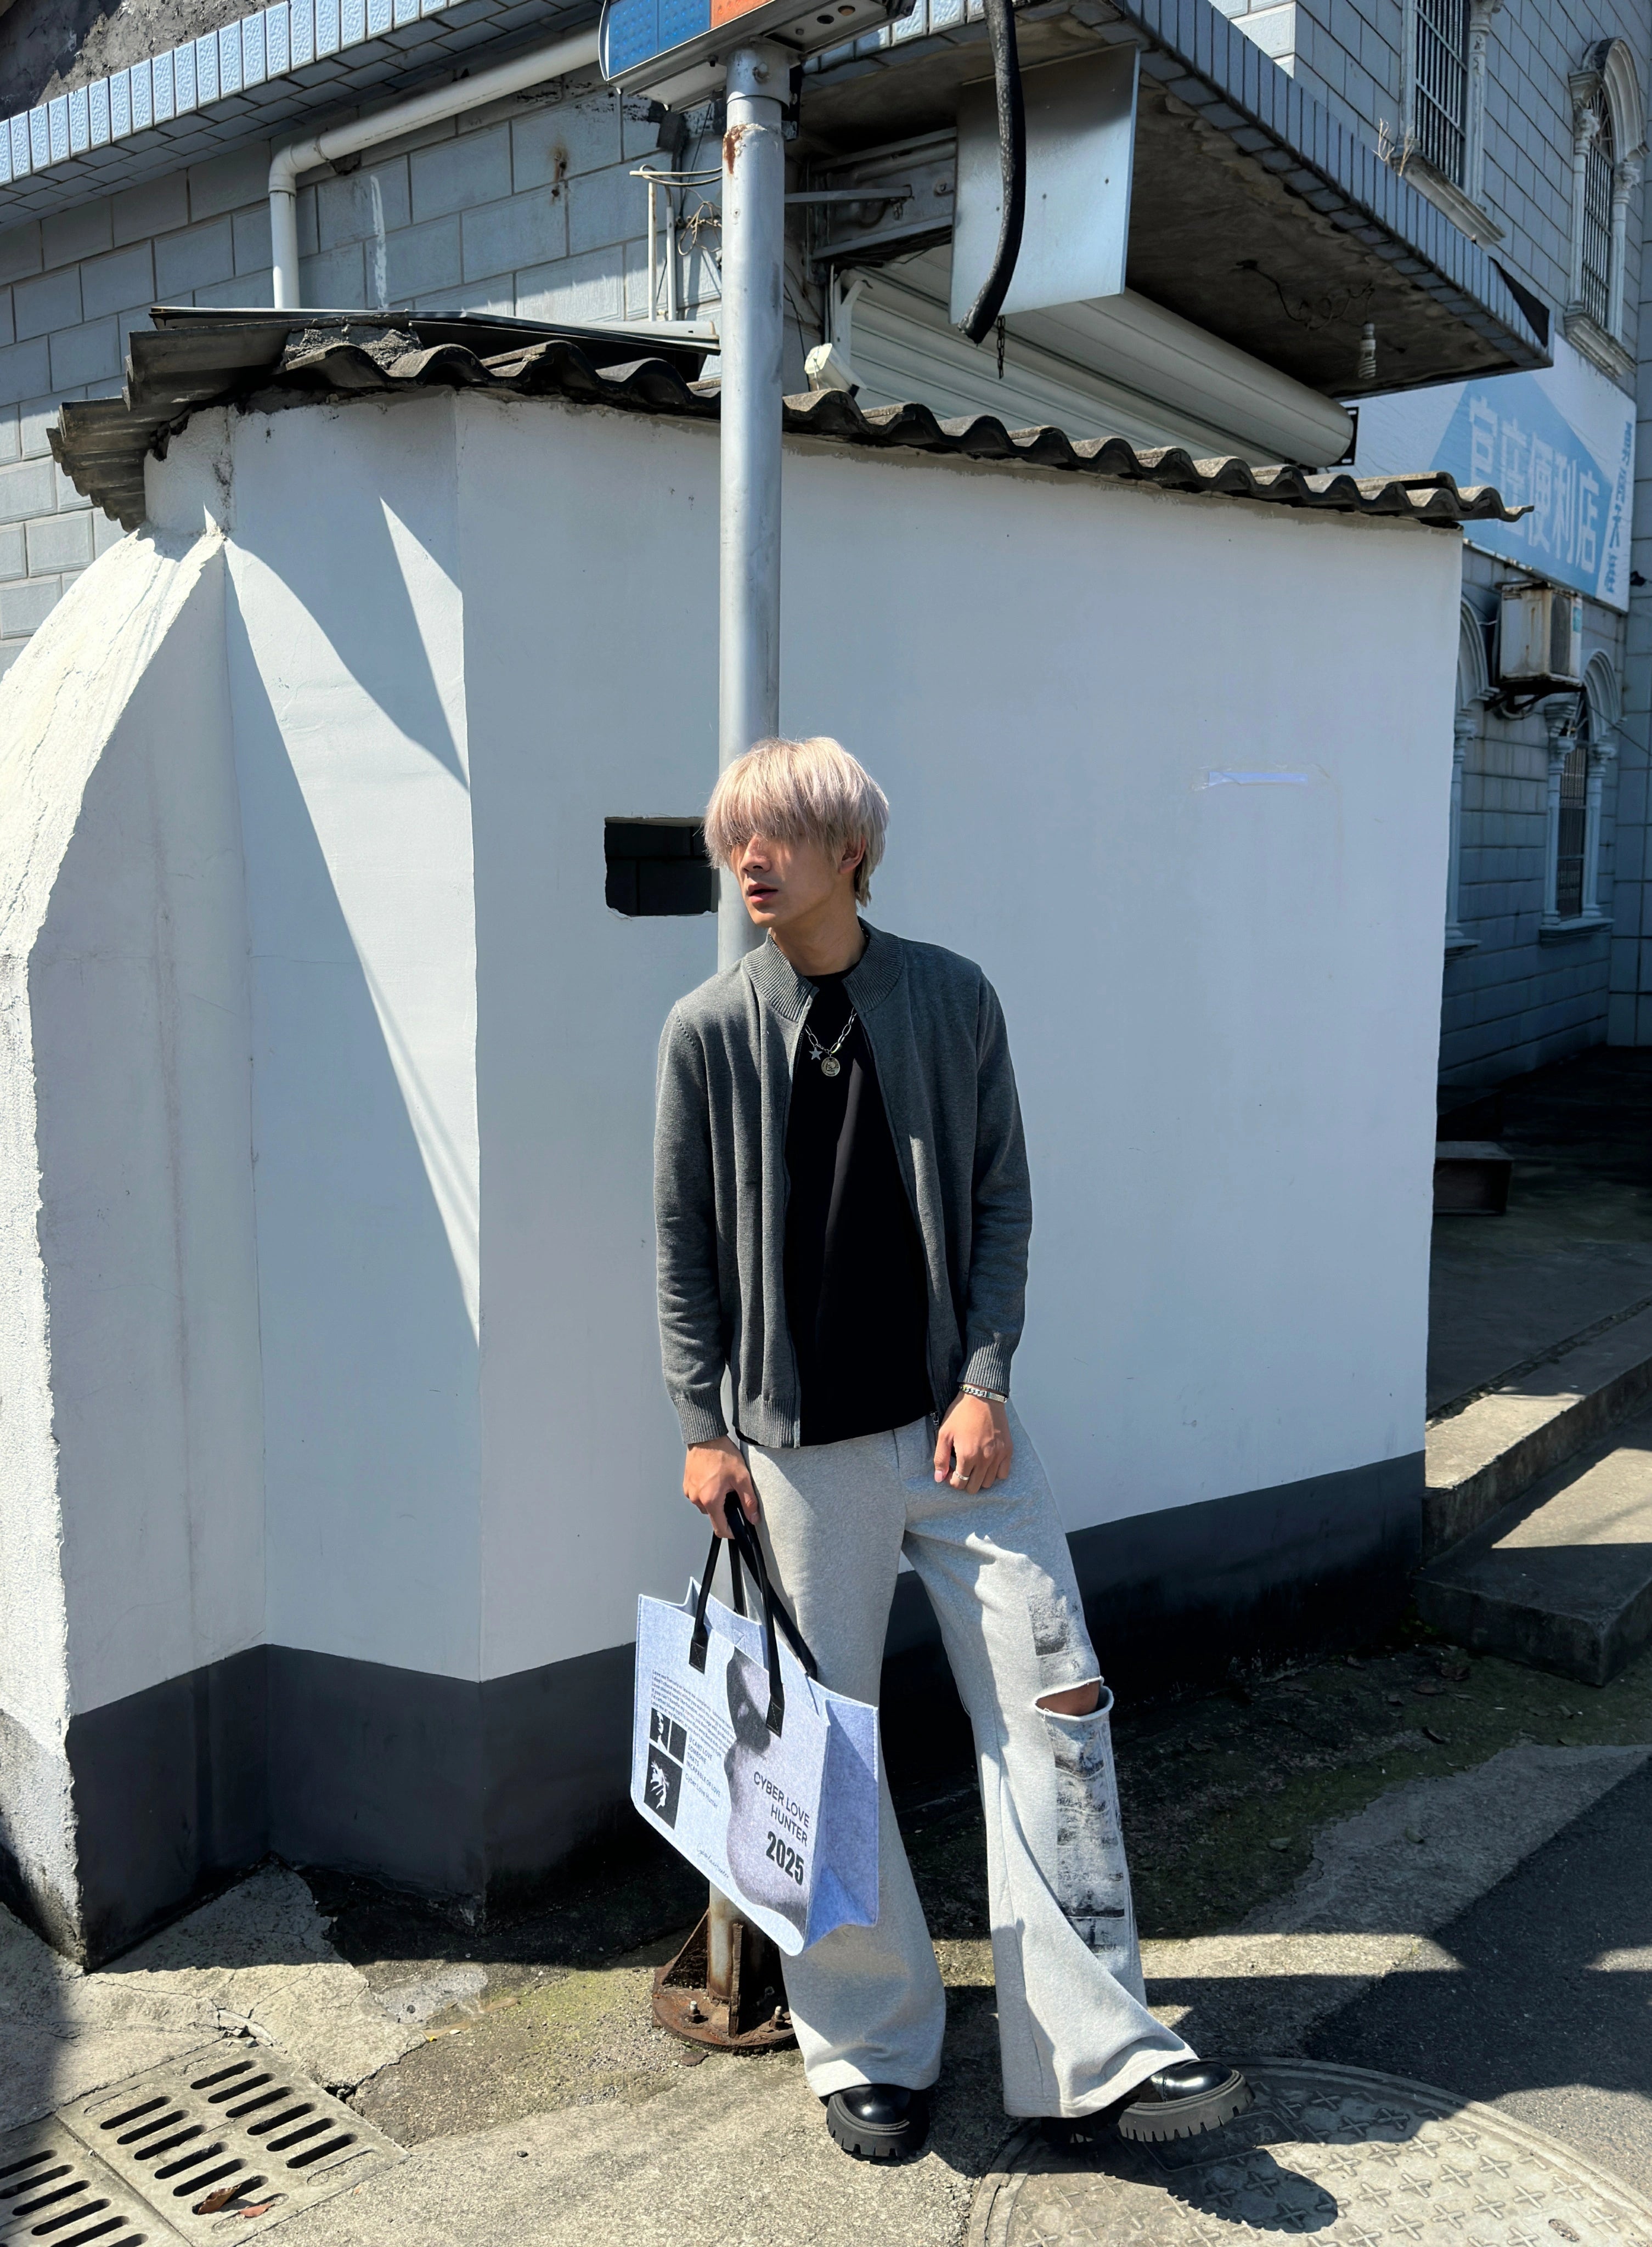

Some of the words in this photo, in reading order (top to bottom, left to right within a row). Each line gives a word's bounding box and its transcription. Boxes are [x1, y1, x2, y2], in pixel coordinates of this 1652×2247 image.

[688, 1744, 707, 1764] SOMEONE
[703, 1748, 712, 1761] LOVE
[685, 1773, 697, 1787] Cyber
[697, 1783, 705, 1797] Love
[706, 1792, 718, 1809] Hunter
[686, 1760, 706, 1783] INCAPABLE
[711, 1783, 720, 1798] LOVE
[754, 1771, 785, 1806] CYBER
[786, 1797, 810, 1828] LOVE
[770, 1804, 808, 1847] HUNTER
[765, 1831, 804, 1886] 2025
